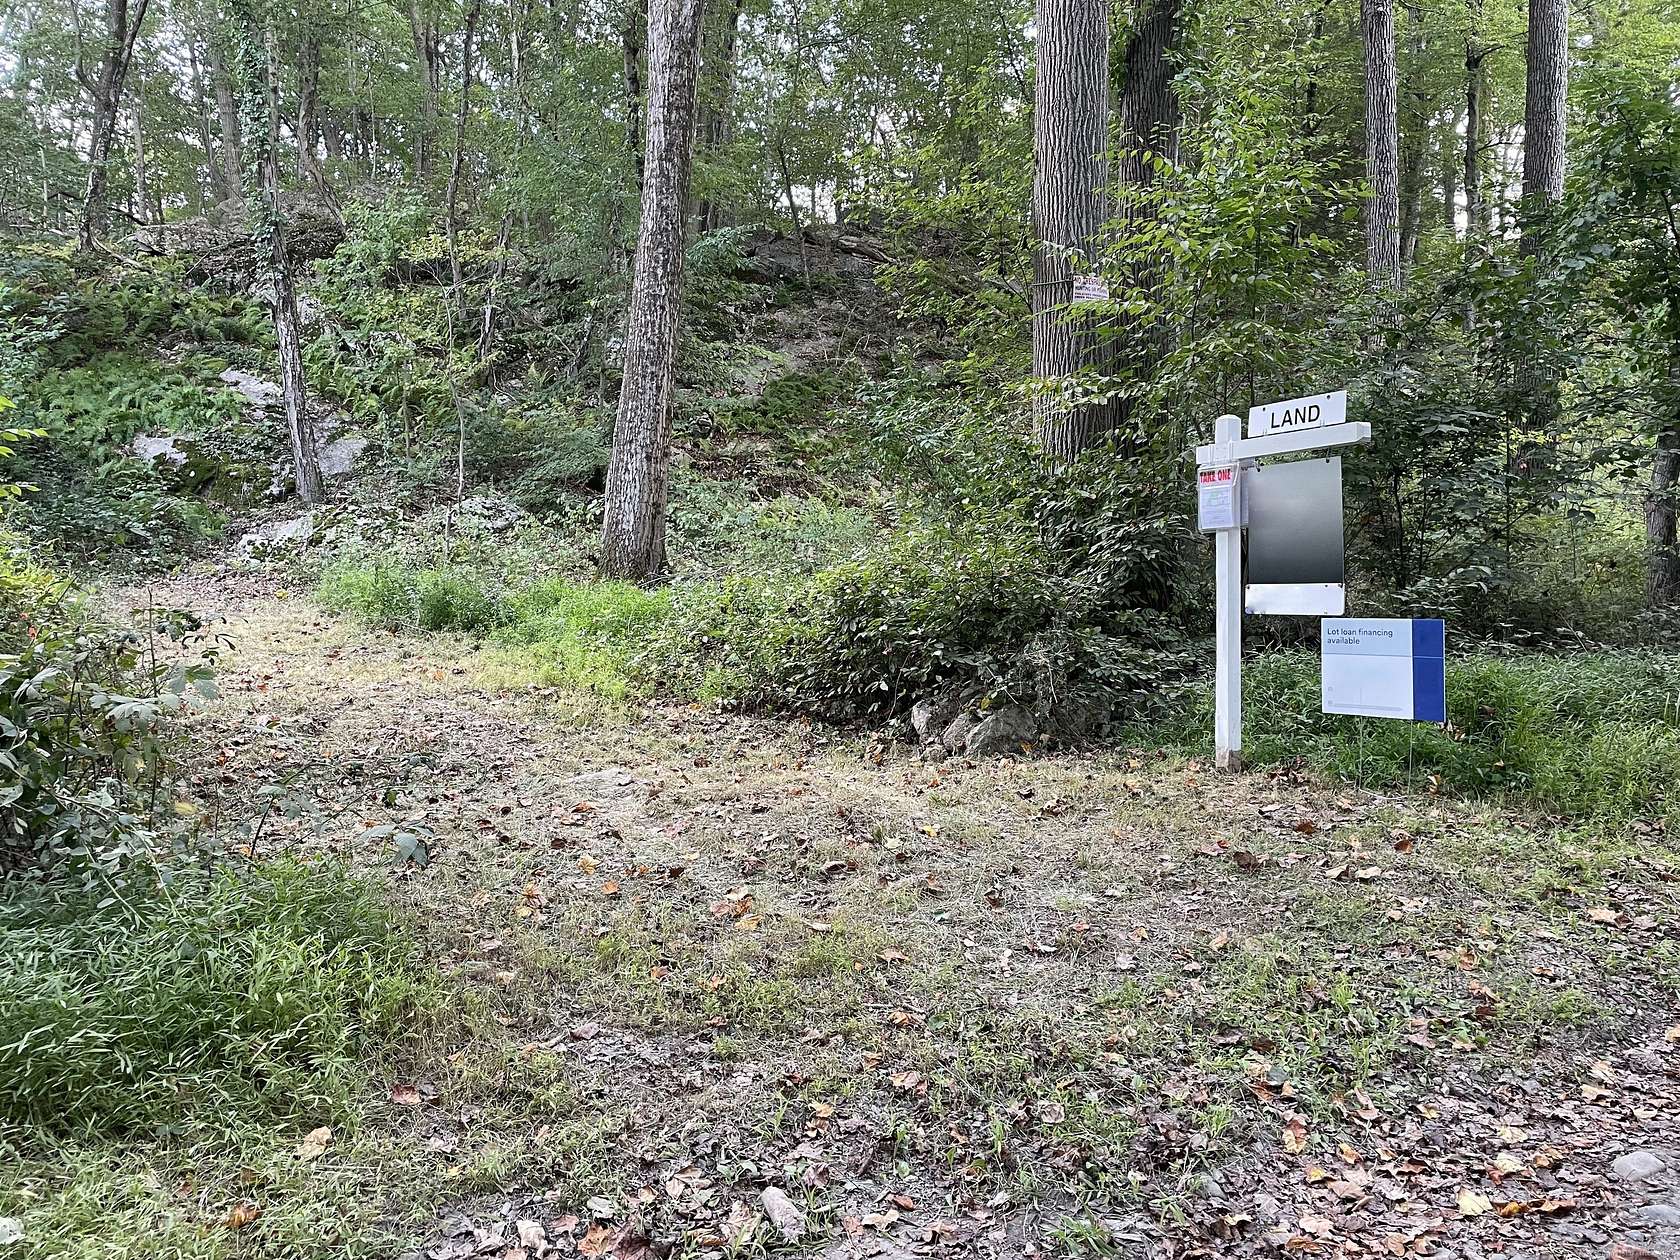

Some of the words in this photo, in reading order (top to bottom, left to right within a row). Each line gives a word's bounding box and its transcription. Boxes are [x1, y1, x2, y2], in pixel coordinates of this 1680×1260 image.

[1271, 405, 1321, 428] LAND
[1200, 471, 1216, 483] TAKE
[1217, 468, 1231, 481] ONE
[1359, 628, 1393, 638] financing
[1327, 637, 1360, 645] available
